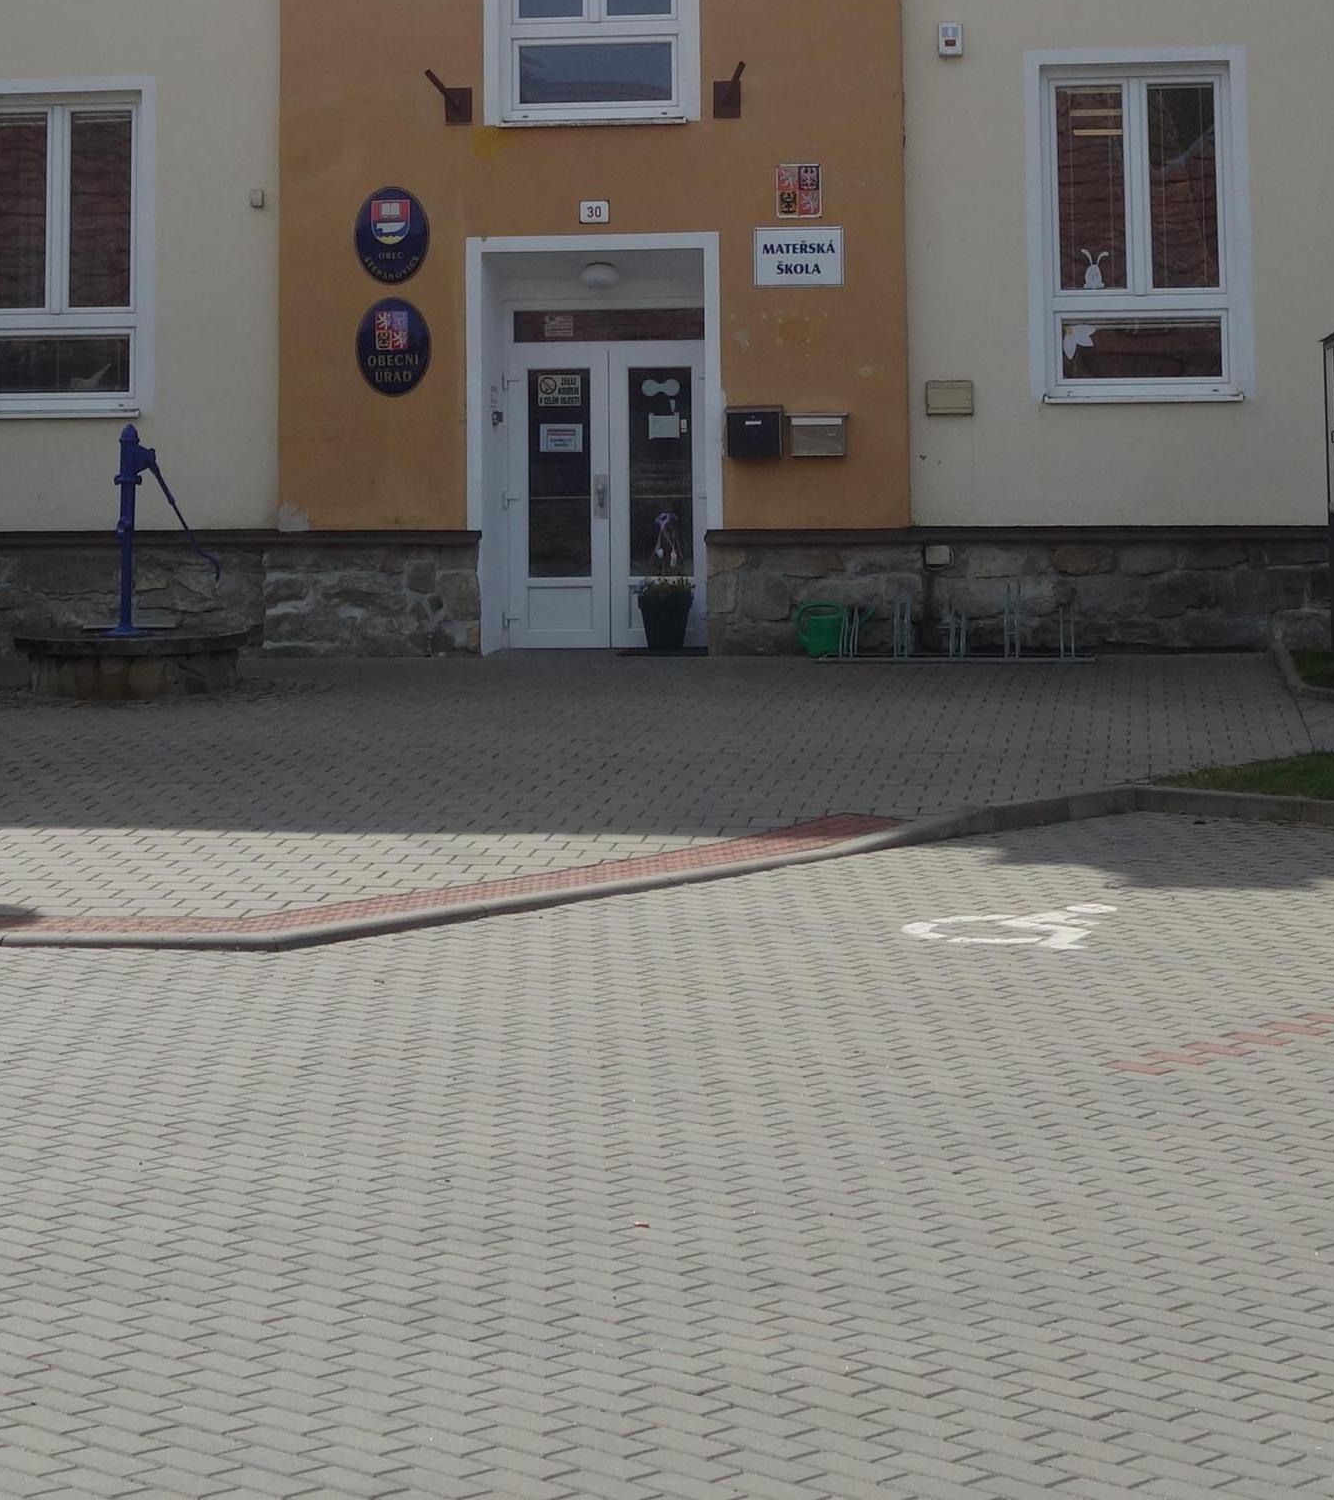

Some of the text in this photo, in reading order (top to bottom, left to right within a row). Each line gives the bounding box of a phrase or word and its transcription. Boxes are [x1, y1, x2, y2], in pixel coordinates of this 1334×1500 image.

[587, 206, 602, 218] 30
[762, 239, 835, 254] MATEŘSKÁ
[378, 251, 404, 260] OBEC
[776, 260, 821, 275] ŠKOLA
